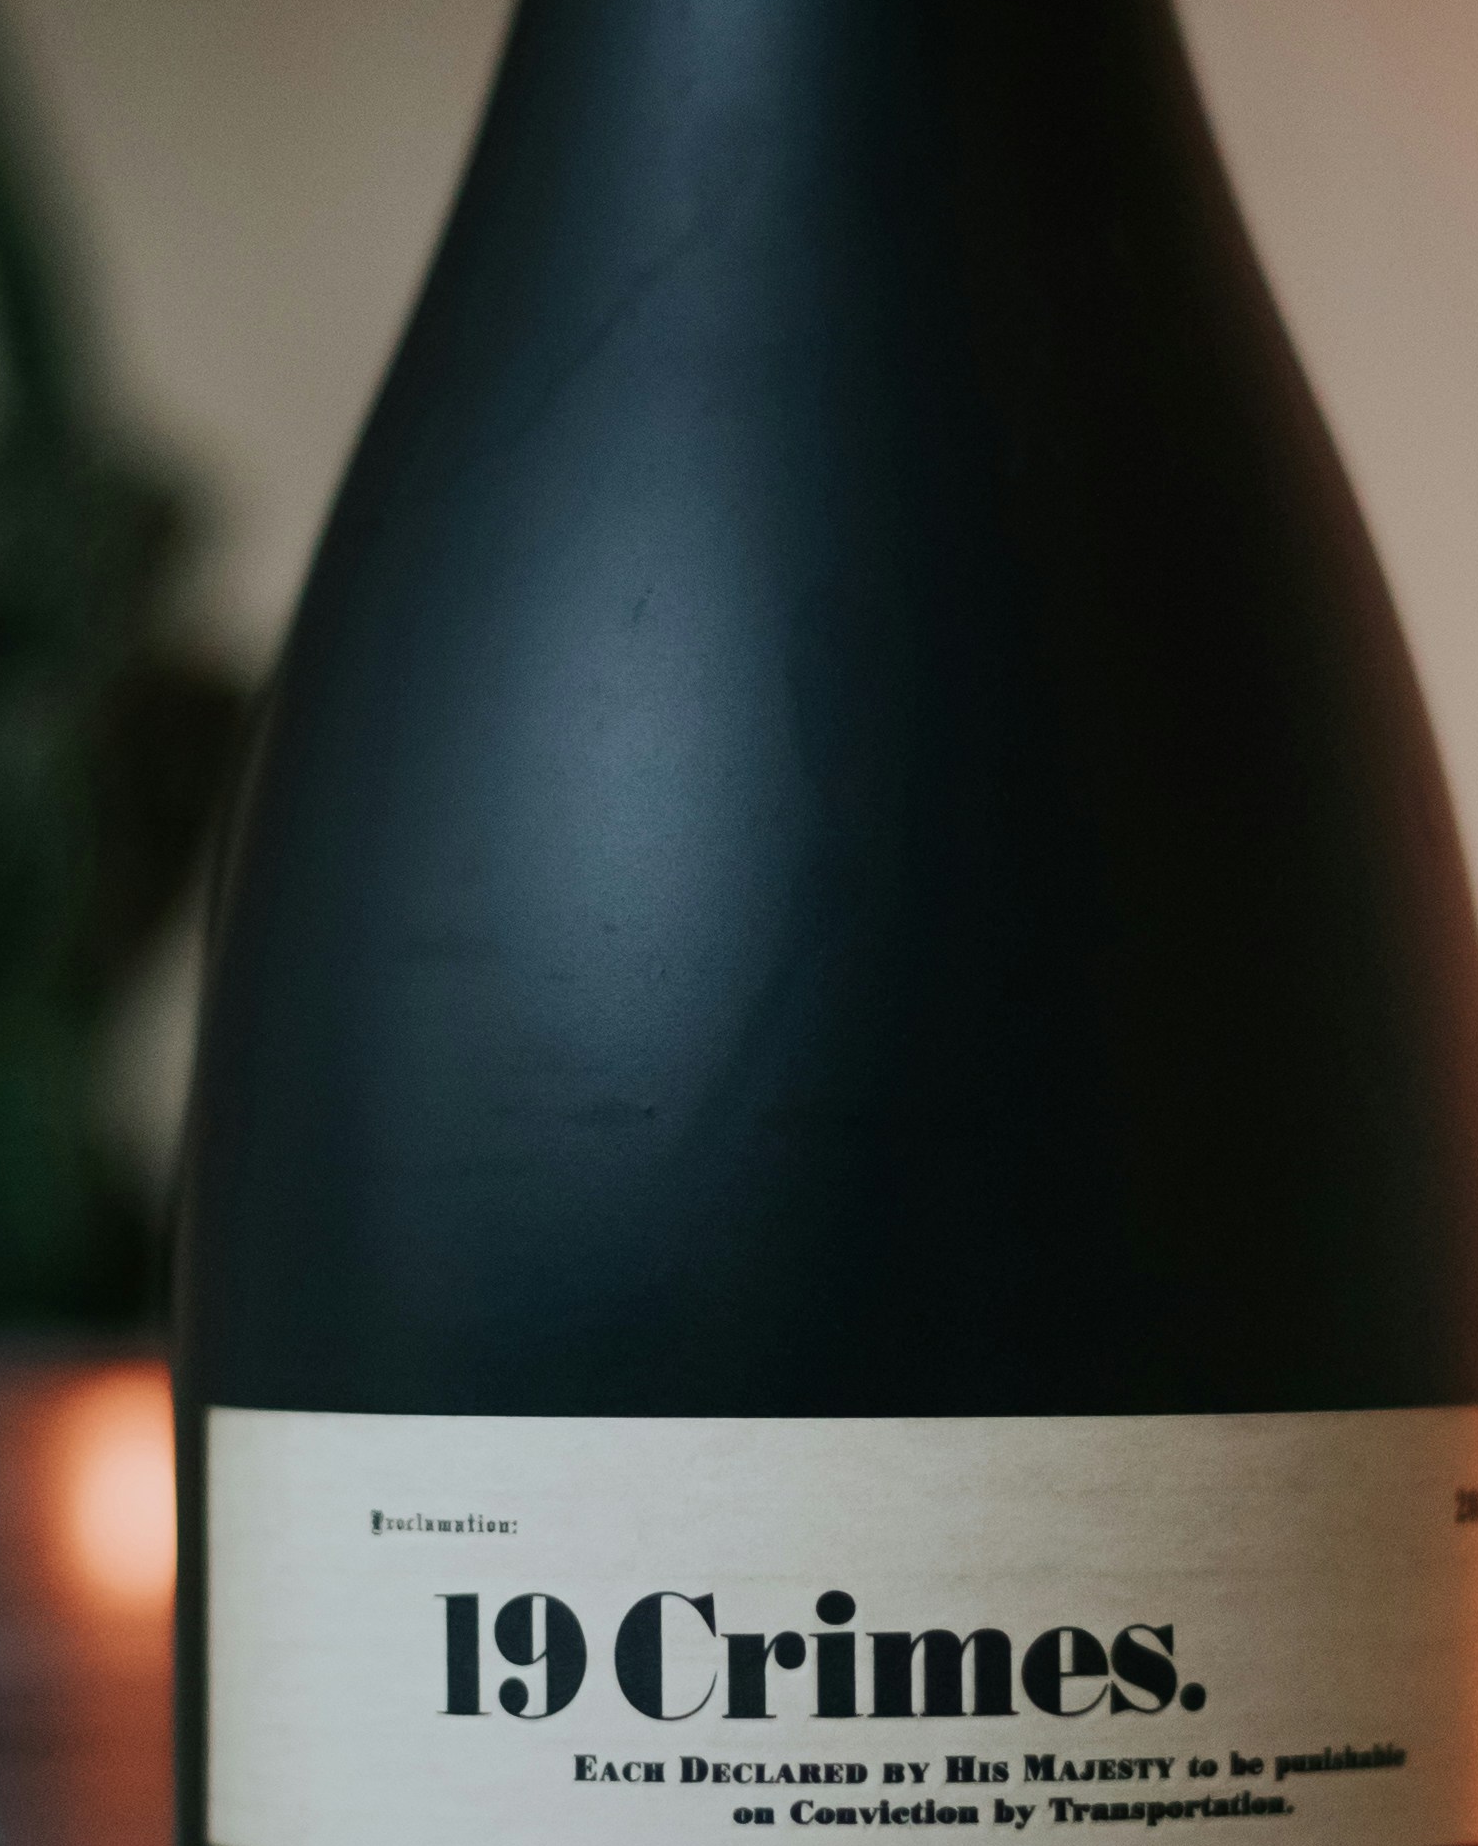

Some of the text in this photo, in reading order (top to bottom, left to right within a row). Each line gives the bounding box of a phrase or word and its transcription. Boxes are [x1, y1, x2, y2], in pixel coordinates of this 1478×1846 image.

[371, 1509, 518, 1535] Proclamation:
[435, 1589, 1207, 1721] 19 Crimes.
[573, 1753, 666, 1783] EACH
[678, 1755, 869, 1784] DECLARED
[944, 1754, 1010, 1784] HIS
[1022, 1752, 1176, 1783] MAJESTY
[1187, 1755, 1219, 1779] to
[1229, 1749, 1265, 1777] be
[732, 1790, 1296, 1830] on Conviction by Transportation.
